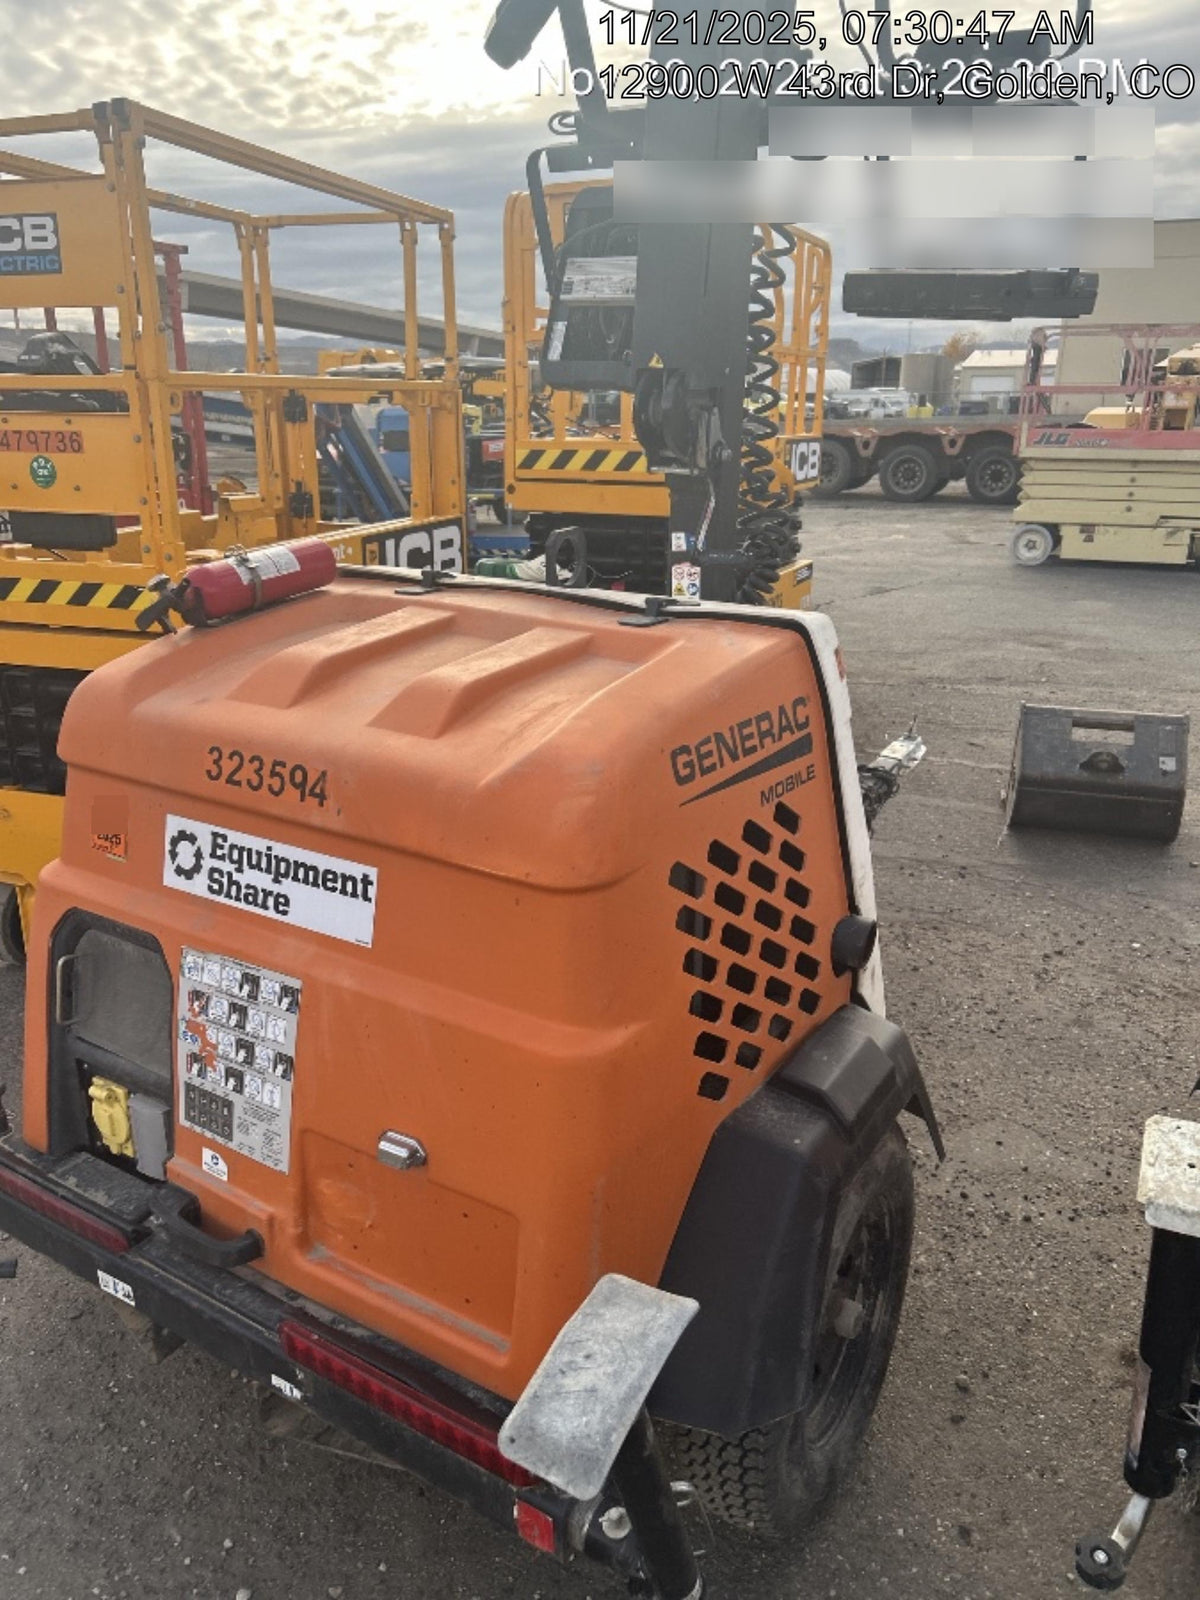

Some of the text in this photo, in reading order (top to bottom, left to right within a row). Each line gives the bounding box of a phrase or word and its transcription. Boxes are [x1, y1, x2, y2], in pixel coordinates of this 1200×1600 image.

[0, 430, 81, 453] 479736
[670, 696, 810, 787] GENERAC
[205, 746, 328, 808] 323594
[759, 763, 816, 807] MOBILE
[207, 866, 290, 916] Share
[209, 830, 374, 903] Equipment
